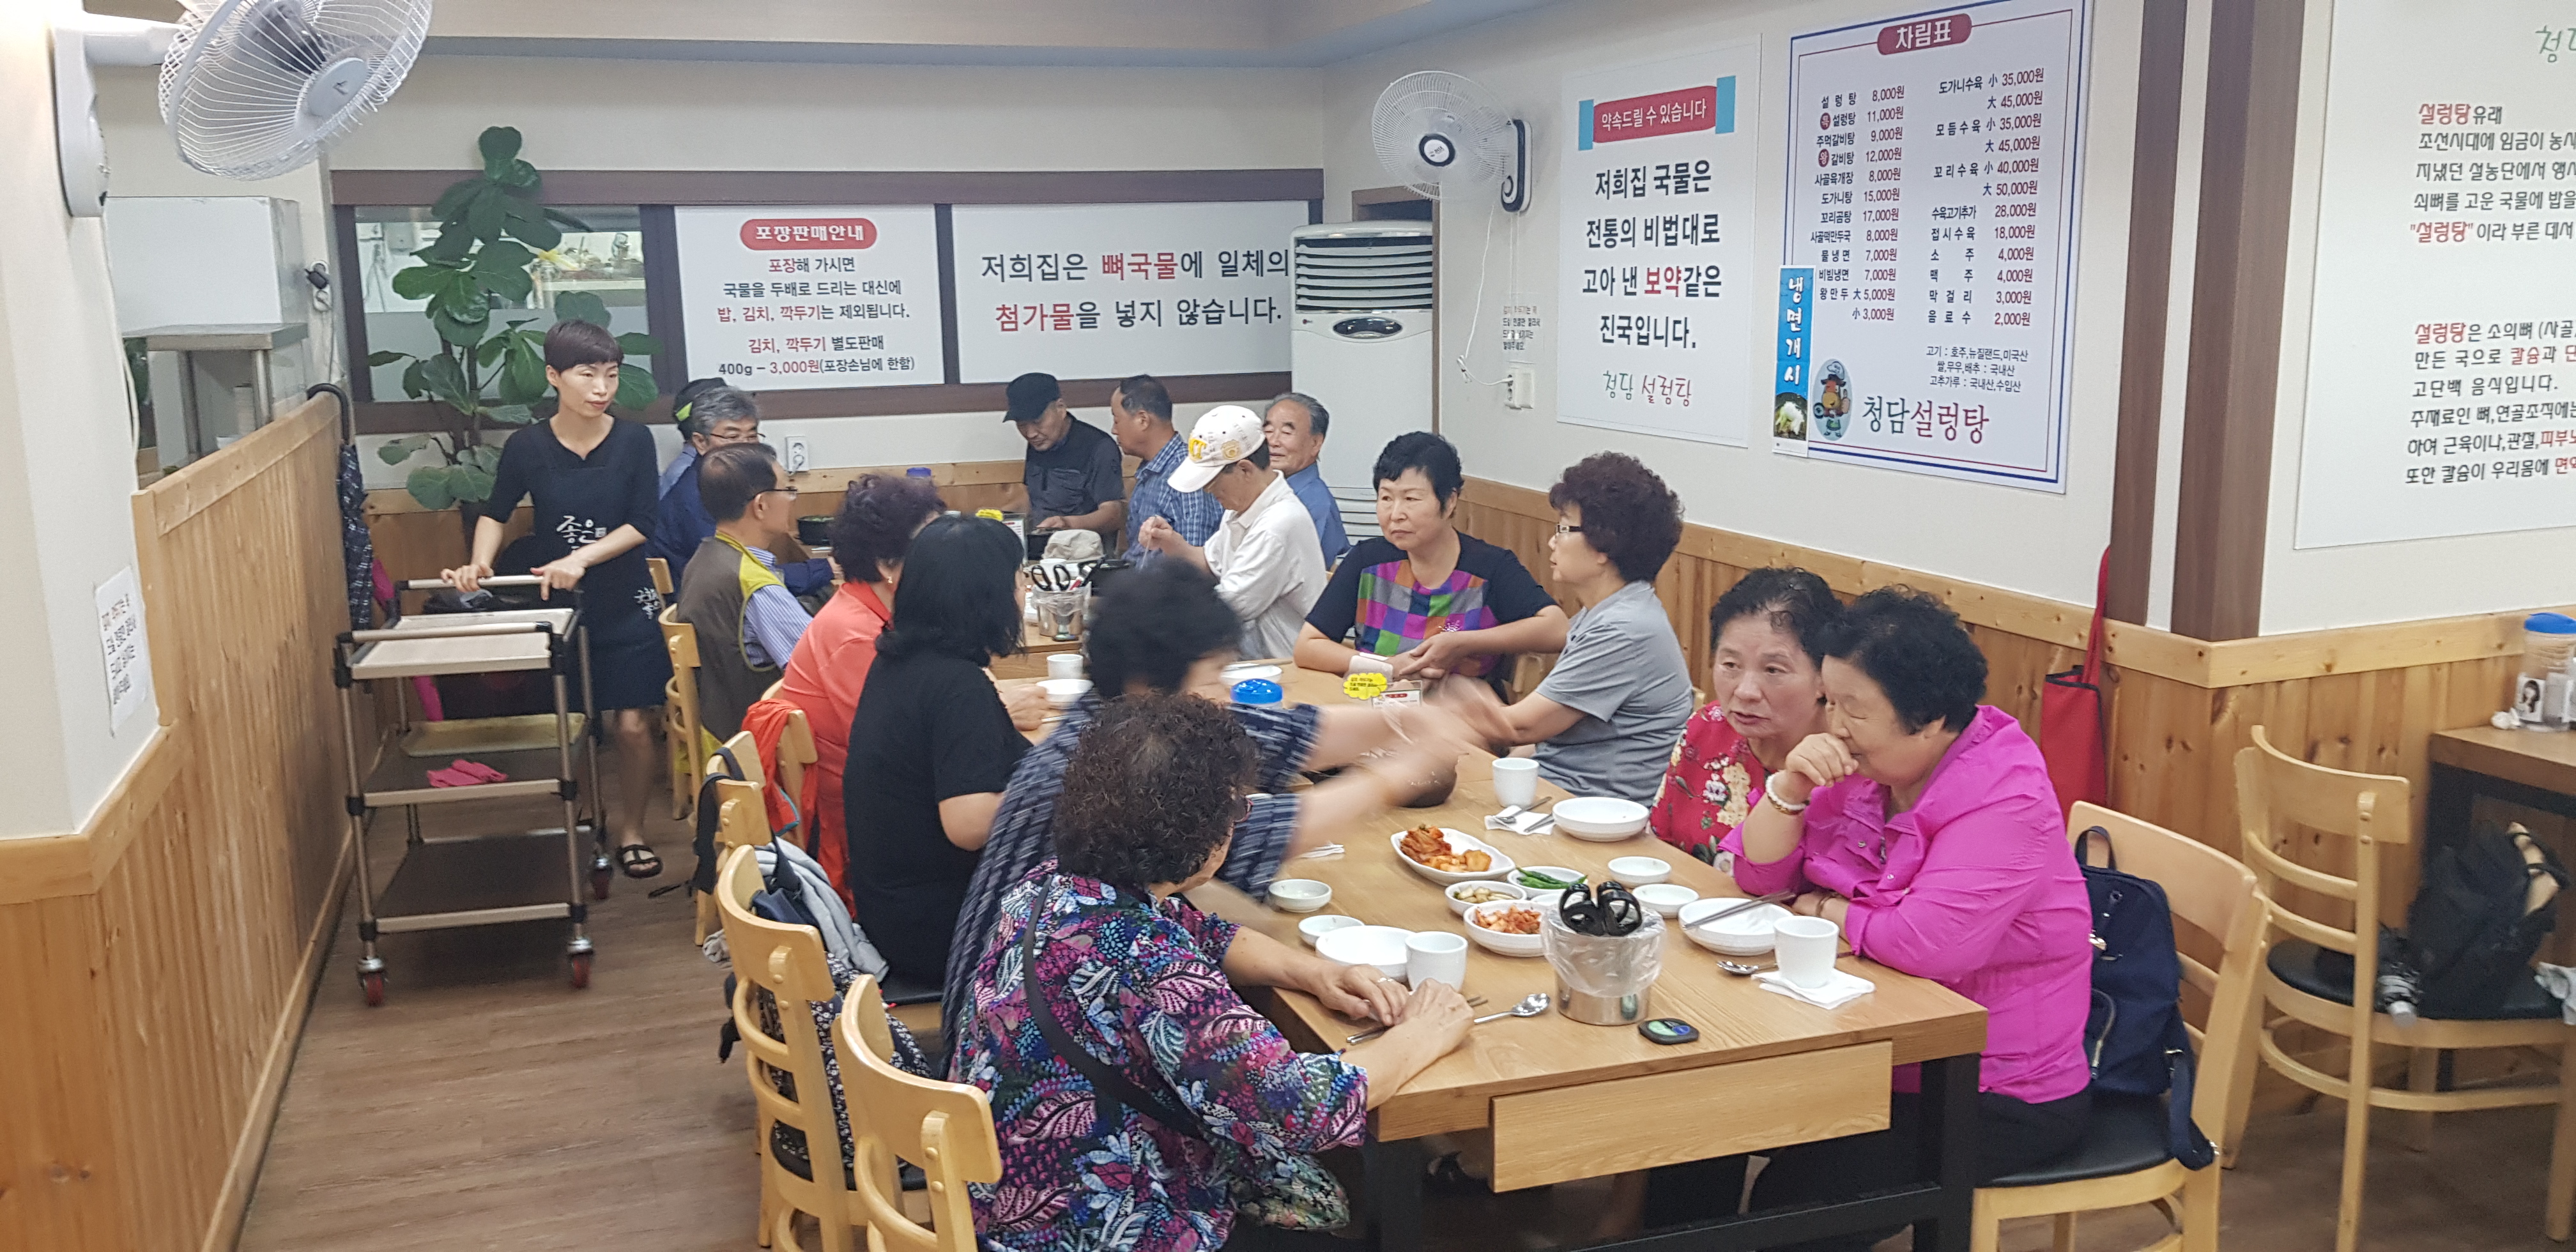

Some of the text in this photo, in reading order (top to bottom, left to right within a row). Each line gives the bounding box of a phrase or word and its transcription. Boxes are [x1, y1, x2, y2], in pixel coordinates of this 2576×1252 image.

[1895, 19, 1952, 50] 차림표
[1938, 67, 2044, 94] 도가니수육 小 35,000원
[1872, 86, 1905, 102] 8,000원
[1987, 91, 2043, 110] 大 45,000원
[1601, 98, 1706, 132] 약속드릴 수 있습니다
[1832, 112, 1856, 127] 설렁탕
[1867, 106, 1904, 123] 11,000원
[1986, 117, 1996, 132] 小
[2000, 113, 2042, 131] 35,000원
[1816, 126, 1903, 148] 주먹갈비탕 9,000원
[1985, 135, 2041, 153] 大 45,000원
[2418, 132, 2495, 151] 조선시대에
[2499, 132, 2544, 151] 임금이
[1831, 151, 1855, 166] 갈비탕
[1866, 147, 1902, 162] 12,000원
[1984, 160, 1993, 175] 小
[1997, 158, 2039, 174] 40,000원
[2416, 162, 2462, 181] 지냈던
[1595, 160, 1712, 200] 저희집 국물은
[1814, 167, 1901, 187] 사골육개장 8,000원
[1821, 188, 1900, 205] 도가니탕 15,000원
[1982, 180, 2038, 197] 大 50,000원
[2413, 191, 2576, 211] 쇠뼈를 고운 국물에 밥을
[1820, 208, 1899, 224] 꼬리곰탕 17,000원
[1931, 202, 2037, 220] 수육고기추가 28,000원
[755, 224, 864, 242] 포장판매안내
[1587, 213, 1719, 249] 전통의 비법대로
[1811, 228, 1898, 243] 사골떡만두국 8,000원
[1995, 224, 2035, 240] 18,000원
[2511, 222, 2540, 241] 부른
[2545, 222, 2573, 240] 데서
[1866, 248, 1897, 262] 7,000원
[1998, 247, 2034, 262] 4,000원
[768, 257, 855, 273] 포장해 가시면
[981, 249, 1289, 283] 저희집은 뼈국물에 일체의
[1582, 265, 1722, 298] 고아 낸 보약같은
[1819, 268, 1896, 282] 비빔냉면 7,000원
[1997, 268, 2033, 284] 4,000원
[723, 279, 901, 298] 국물을 두배로 드리는 대신에
[1853, 287, 1861, 300] 大
[1864, 288, 1895, 301] 5,000원
[1996, 290, 2032, 305] 3,000원
[717, 303, 910, 323] 밥, 김치, 깍두기는 제외됩니다.
[995, 296, 1282, 332] 첨가물을 넣지 않습니다.
[1852, 307, 1894, 321] 小 3,000원
[1995, 312, 2030, 326] 2,000원
[1600, 314, 1696, 349] 진국입니다.
[2414, 323, 2481, 345] 설렁탕은
[2487, 321, 2533, 339] 소의뼈
[748, 335, 884, 353] 김치, 깍두기 별도판매
[1926, 346, 1942, 357] 고기
[719, 363, 753, 376] 400g
[887, 356, 915, 370] 한함)
[2415, 351, 2446, 370] 만든
[2455, 348, 2502, 368] 국으로
[2510, 346, 2557, 365] 칼슘과
[1989, 363, 2015, 377] 국내산
[1603, 370, 1692, 408] 청담 설렁탕
[1930, 375, 1960, 388] 고추가루
[1970, 378, 2021, 393] 국내산,수입산
[2412, 374, 2558, 398] 고단백 음식입니다.
[2411, 408, 2470, 427] 주재료인
[2407, 438, 2437, 456] 하여
[2405, 466, 2435, 484] 또한
[2441, 462, 2485, 484] 칼슘이
[2492, 458, 2549, 480] 우리몸에
[556, 515, 598, 544] 좋은
